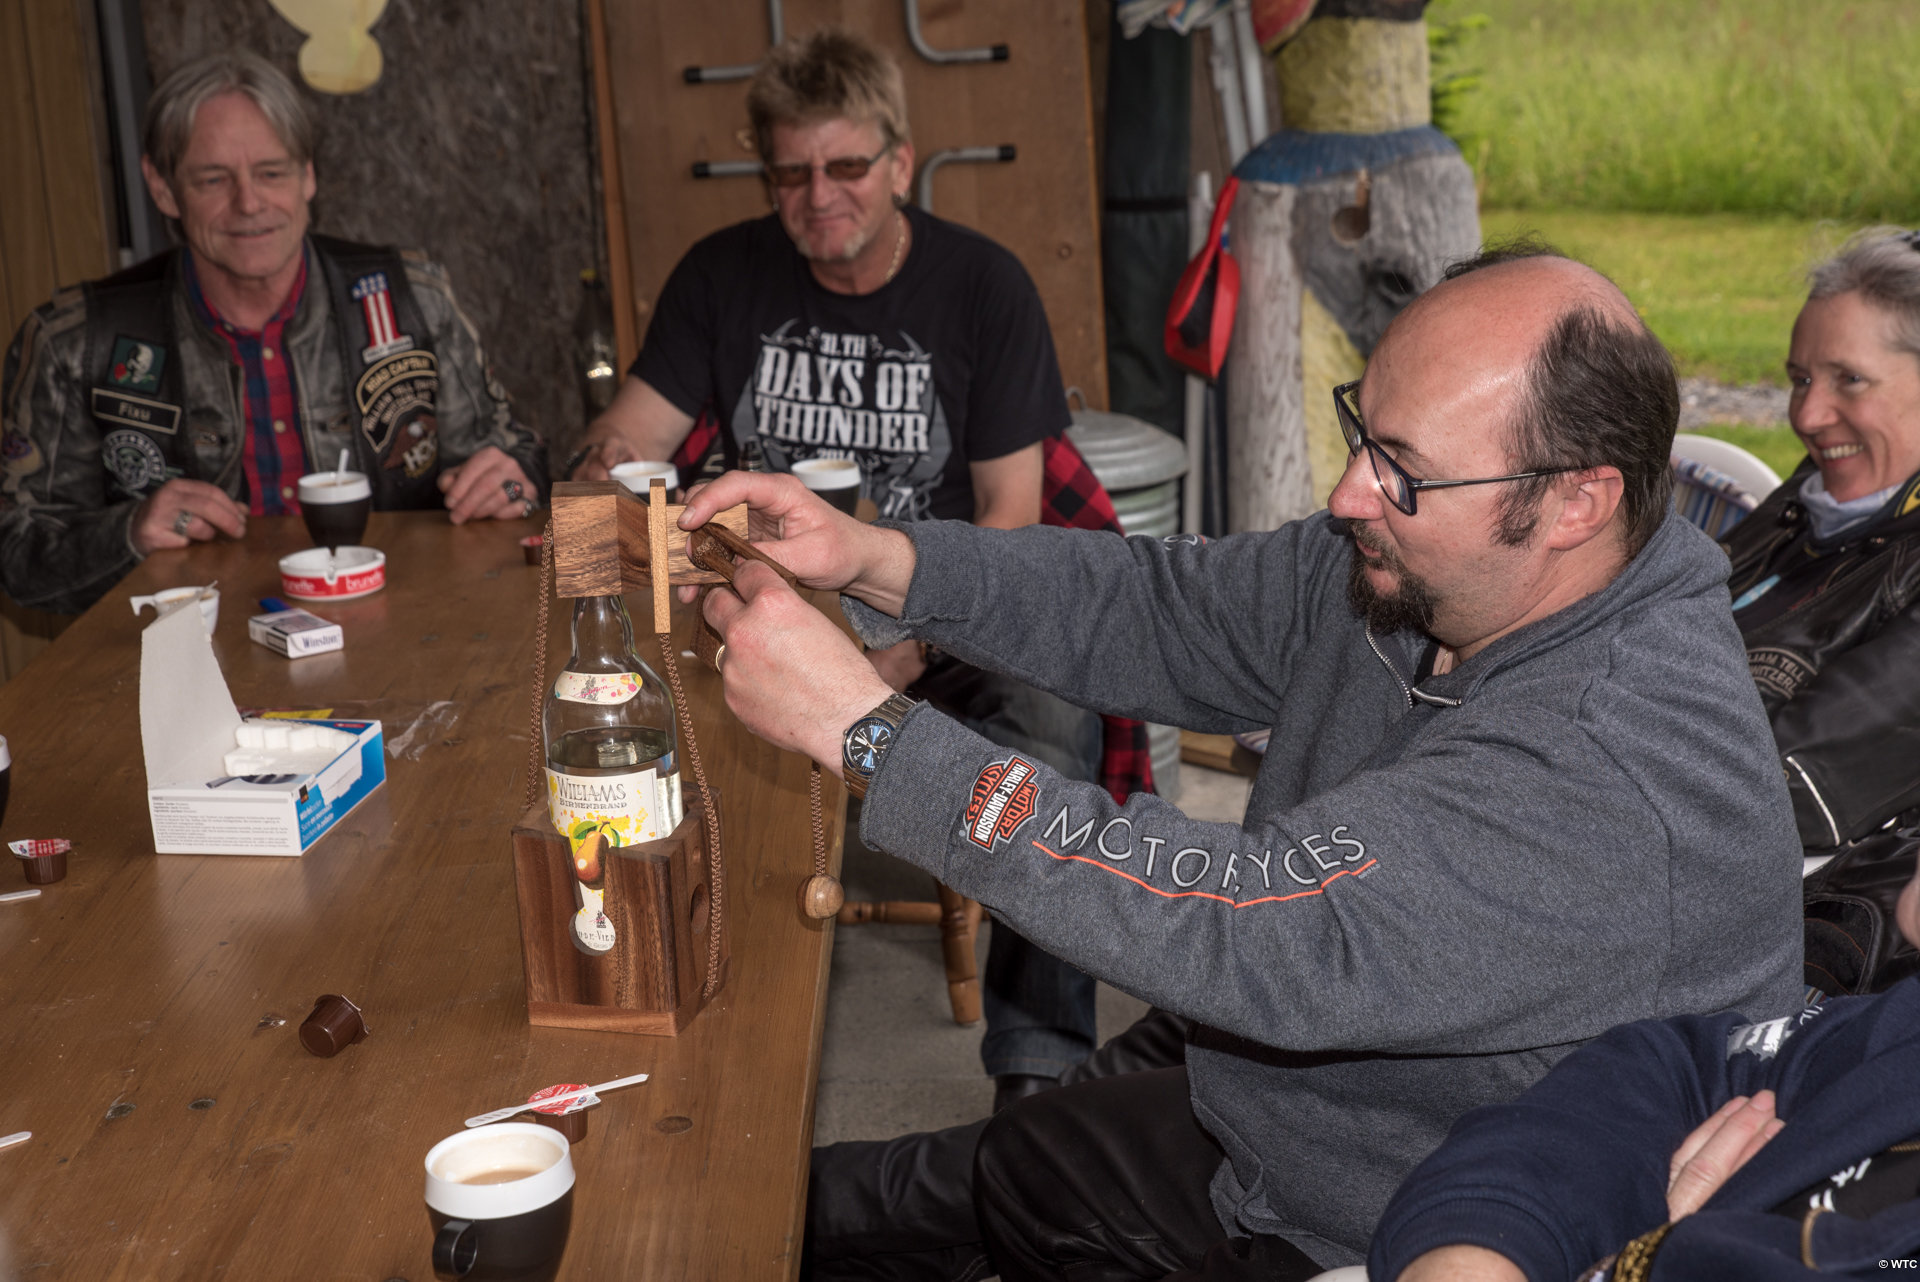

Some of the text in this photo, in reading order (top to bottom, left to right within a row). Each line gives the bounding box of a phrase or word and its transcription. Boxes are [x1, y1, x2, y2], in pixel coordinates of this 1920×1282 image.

[757, 345, 931, 412] DAYS OF
[755, 395, 930, 453] THUNDER
[302, 634, 338, 649] Winston
[1779, 656, 1805, 683] TELL
[560, 798, 628, 810] BIRNENBRAND
[974, 763, 1030, 842] HARLEY-DAVIDSON
[1001, 785, 1033, 828] MOTOR
